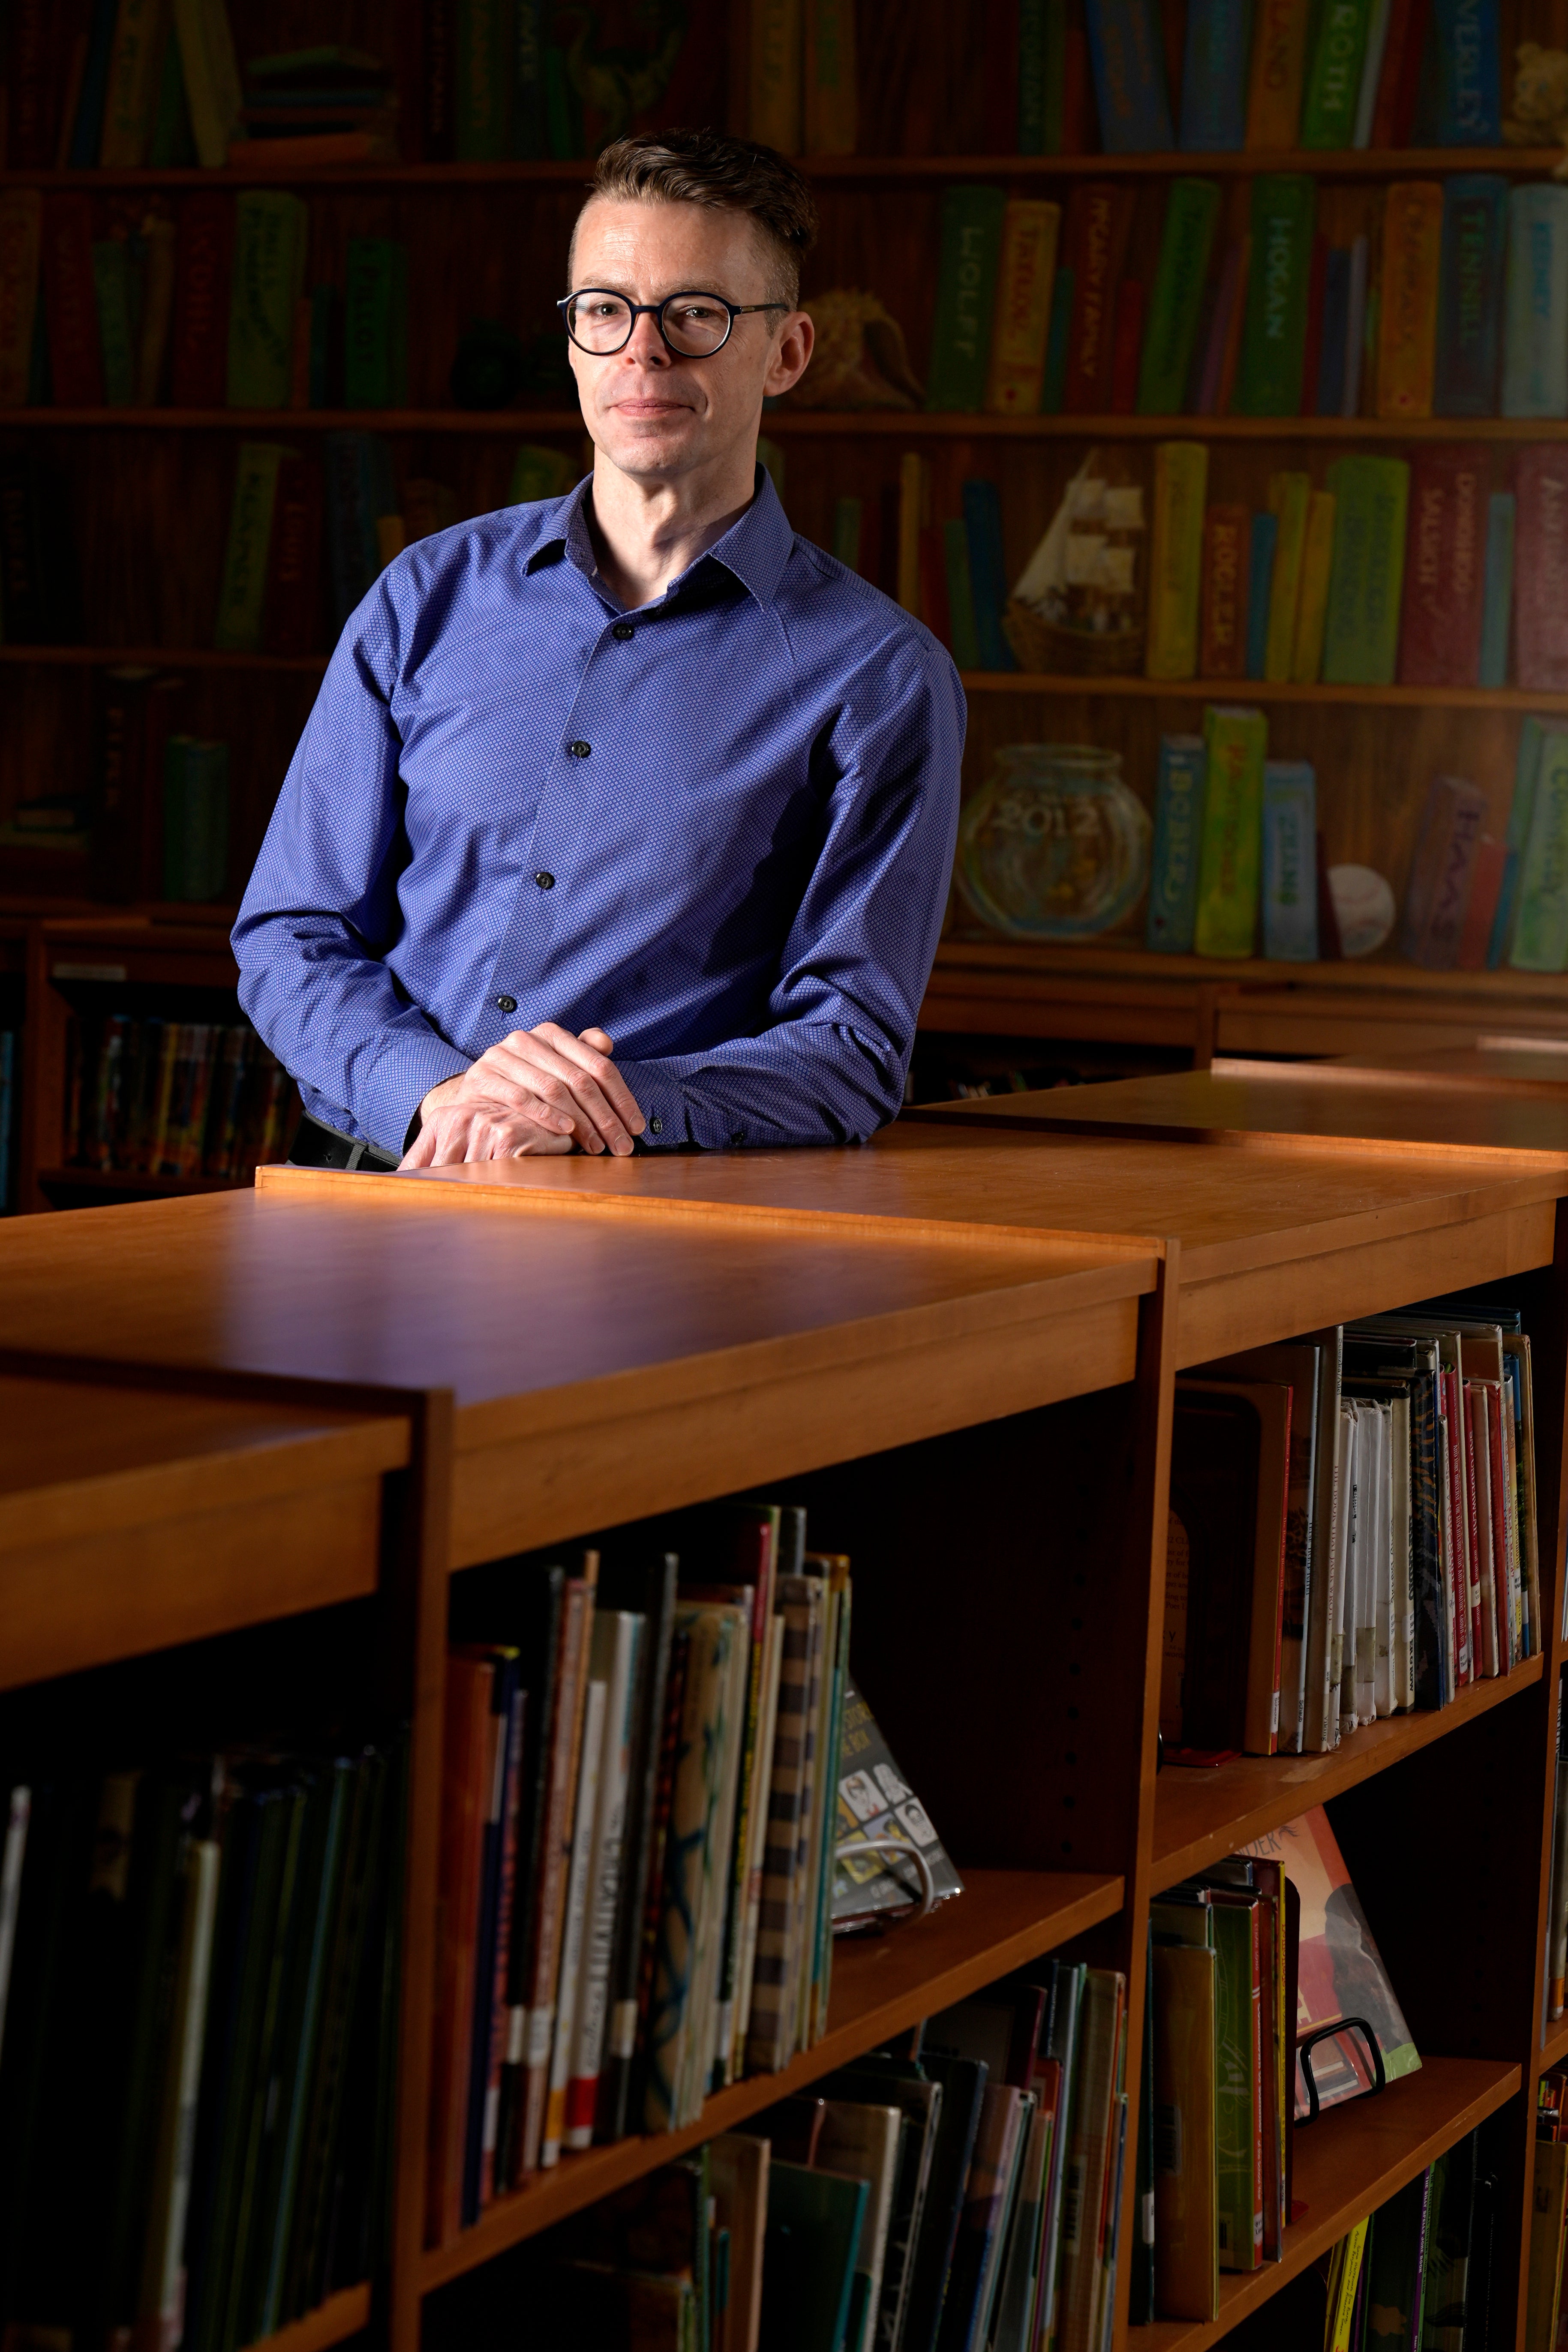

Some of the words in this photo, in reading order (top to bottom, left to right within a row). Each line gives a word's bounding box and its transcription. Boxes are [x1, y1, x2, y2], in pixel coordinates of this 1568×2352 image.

[1323, 4, 1359, 111] ROTH
[953, 225, 985, 360] WOLFF
[1265, 217, 1292, 339] HOGAN
[1430, 810, 1479, 940] HAAS
